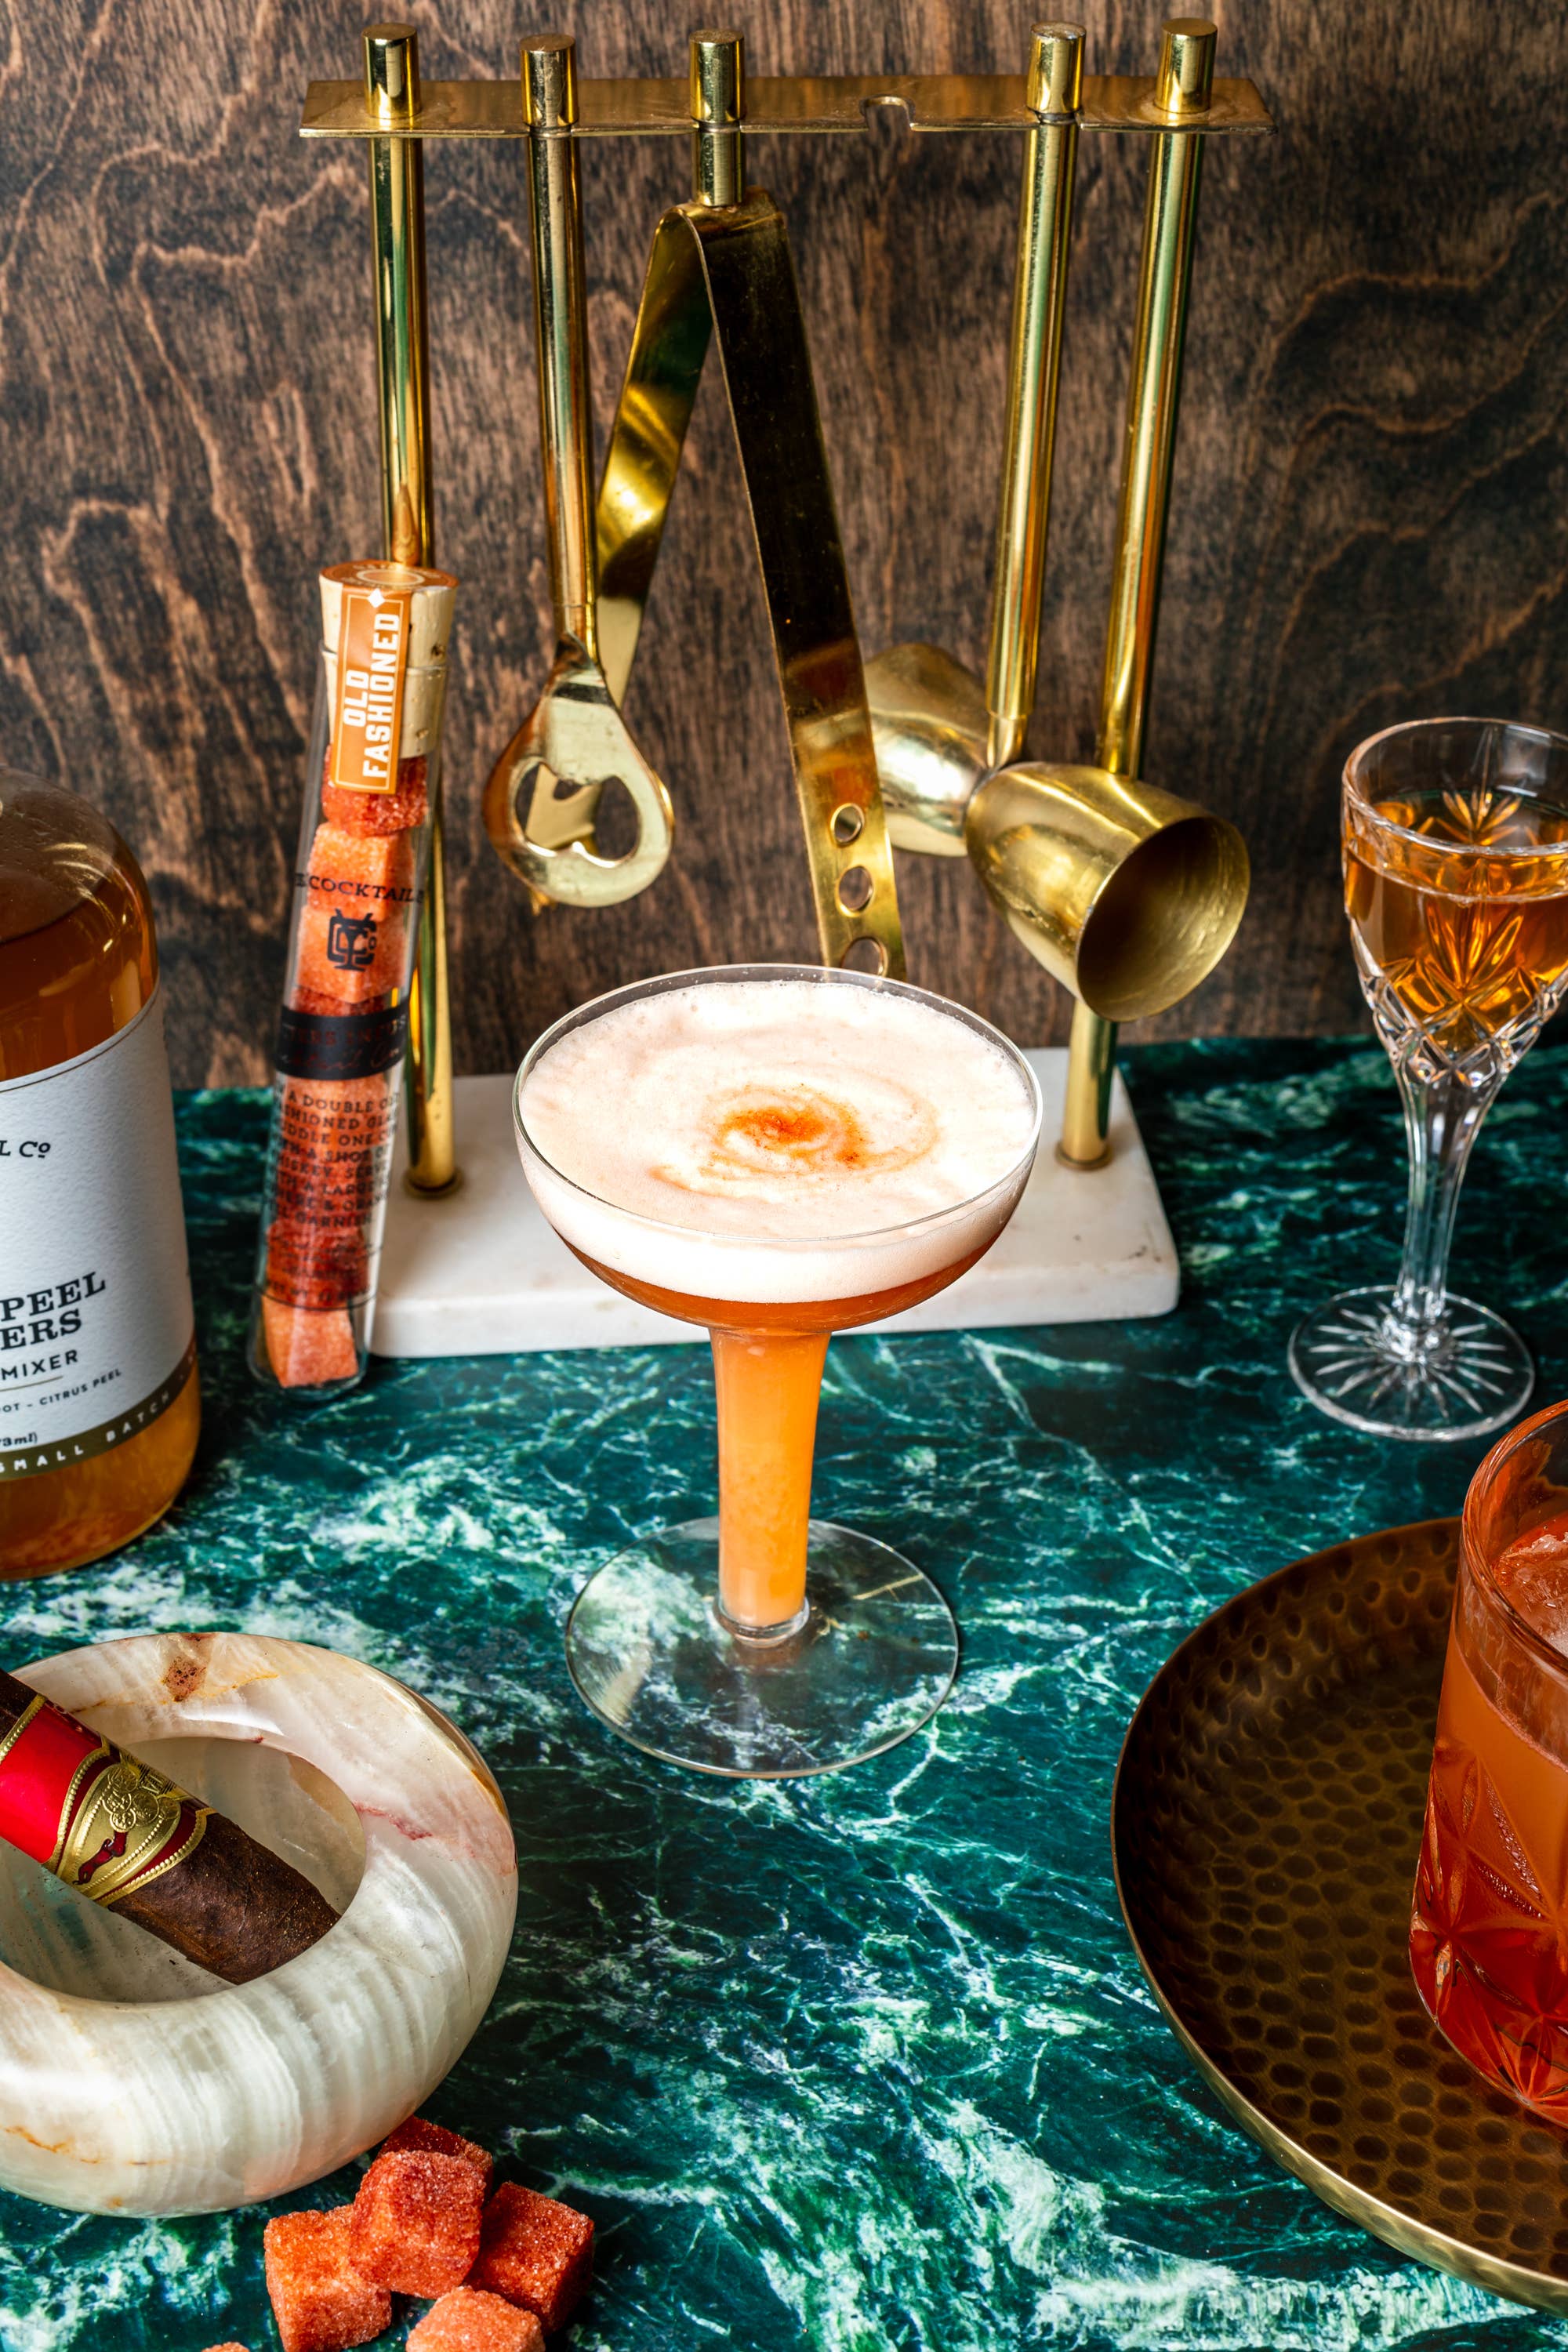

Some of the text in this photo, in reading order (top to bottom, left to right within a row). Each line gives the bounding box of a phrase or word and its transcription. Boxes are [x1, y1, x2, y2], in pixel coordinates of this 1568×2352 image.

[343, 670, 369, 727] OLD
[362, 613, 399, 778] FASHIONED
[303, 1094, 374, 1113] DOUBLE
[338, 1133, 373, 1146] ONE
[0, 1272, 106, 1322] PEEL
[2, 1349, 78, 1381] MIXER
[0, 1403, 20, 1412] OT
[39, 1384, 88, 1406] CITRUS
[93, 1369, 122, 1388] PEEL
[106, 1391, 169, 1442] BATCH
[0, 1432, 38, 1447] 3ml)
